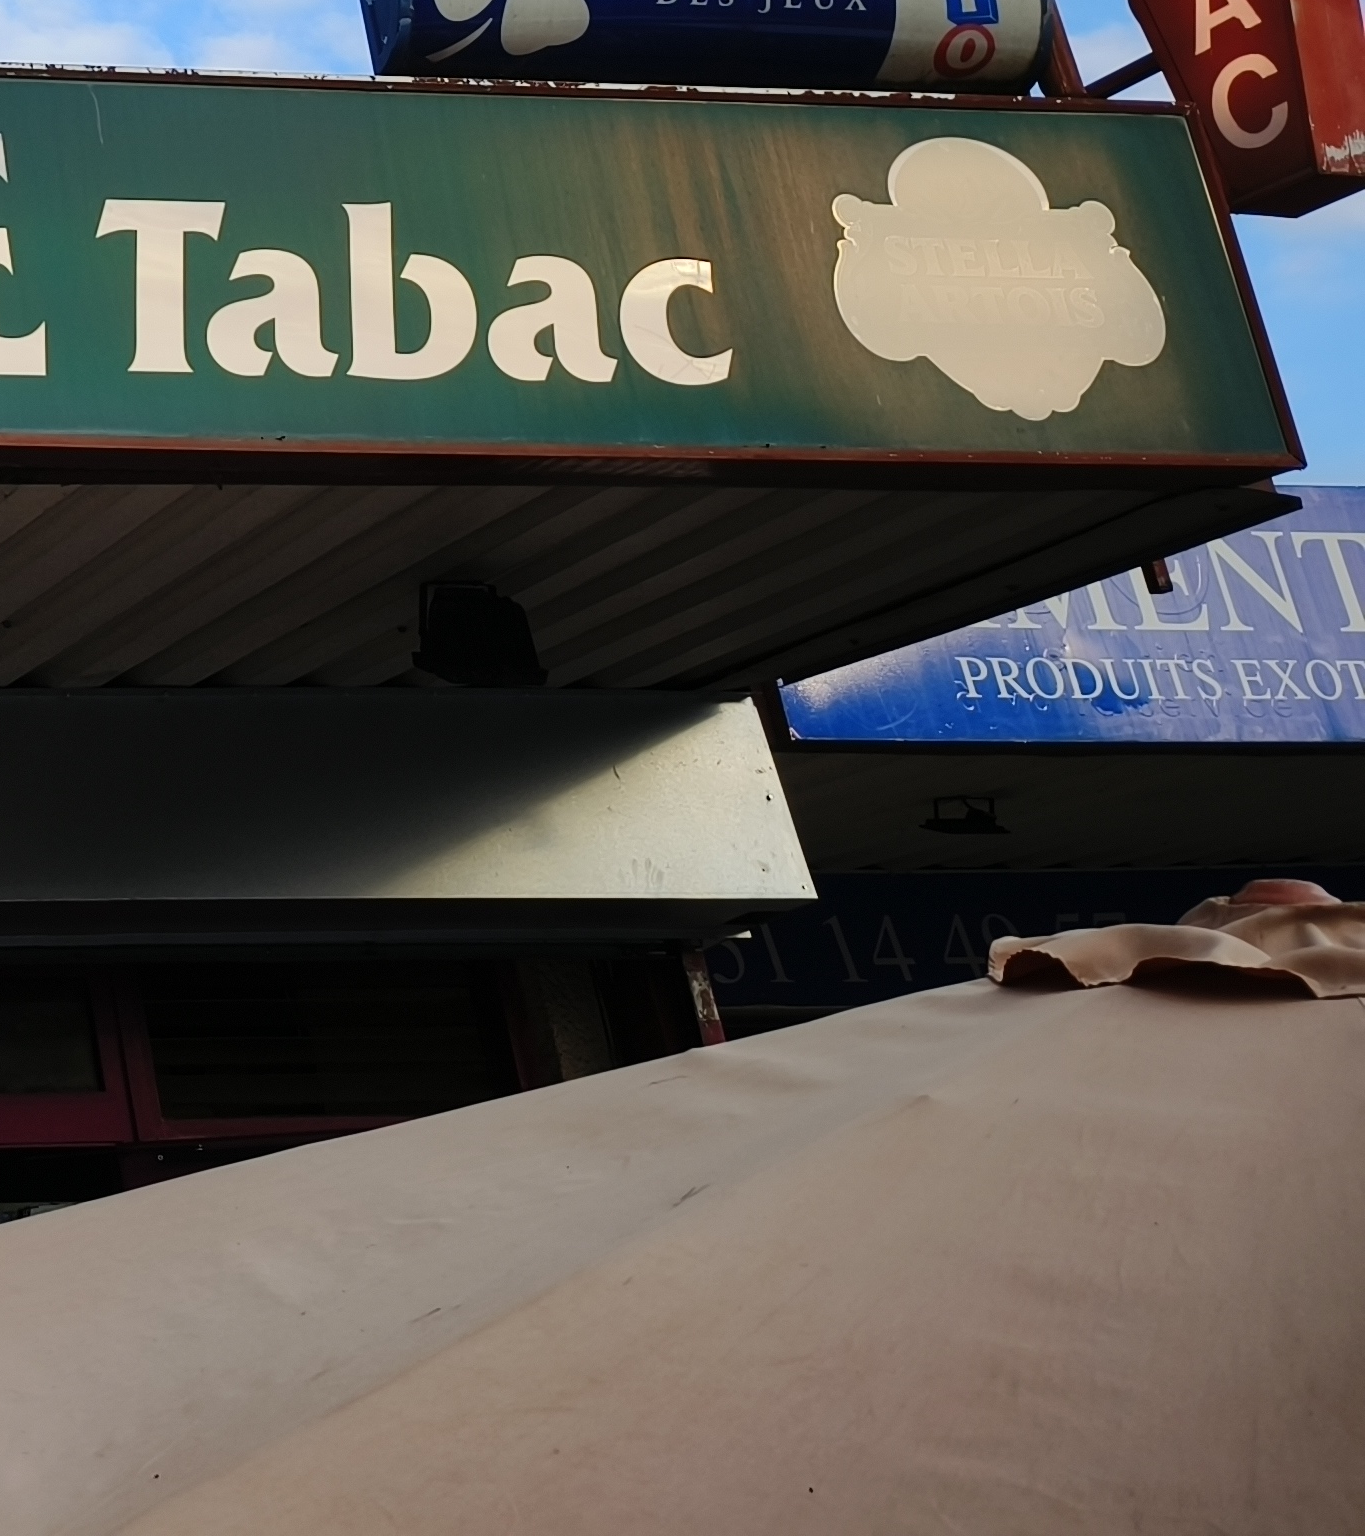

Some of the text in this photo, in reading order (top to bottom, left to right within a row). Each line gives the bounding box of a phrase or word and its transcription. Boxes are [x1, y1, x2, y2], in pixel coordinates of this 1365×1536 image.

[884, 234, 1095, 280] STELLA
[95, 198, 733, 386] Tabac
[897, 284, 1106, 329] ARTOIS
[969, 530, 1365, 634] ENT
[955, 656, 1223, 701] PRODUITS
[1231, 658, 1365, 701] EXOT
[823, 914, 916, 984] 14
